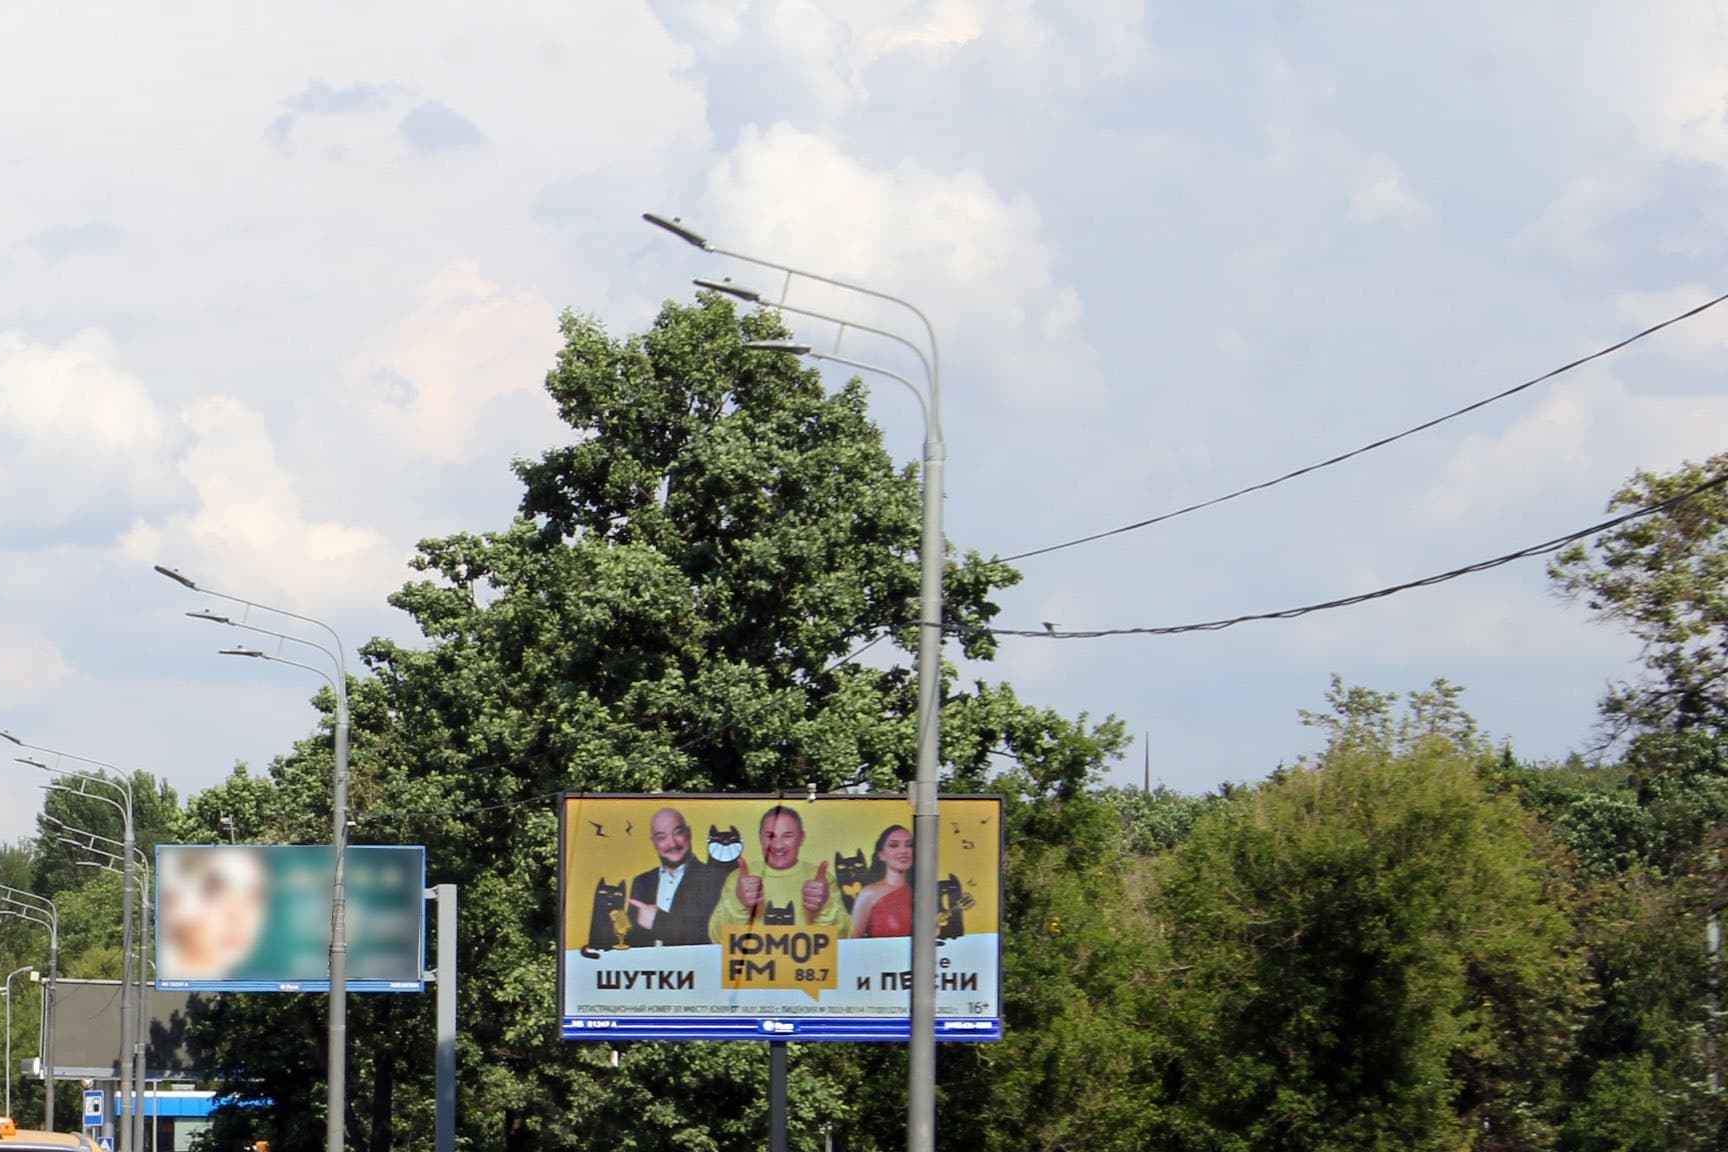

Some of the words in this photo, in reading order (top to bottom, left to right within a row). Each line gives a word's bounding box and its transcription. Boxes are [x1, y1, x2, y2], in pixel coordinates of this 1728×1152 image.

[729, 932, 830, 963] ЮМОР
[596, 970, 695, 990] ШУТКИ
[729, 960, 776, 981] FM
[794, 968, 829, 982] 88.7
[857, 976, 870, 990] и
[881, 970, 978, 991] ПЕНИ
[967, 1001, 990, 1014] 16+
